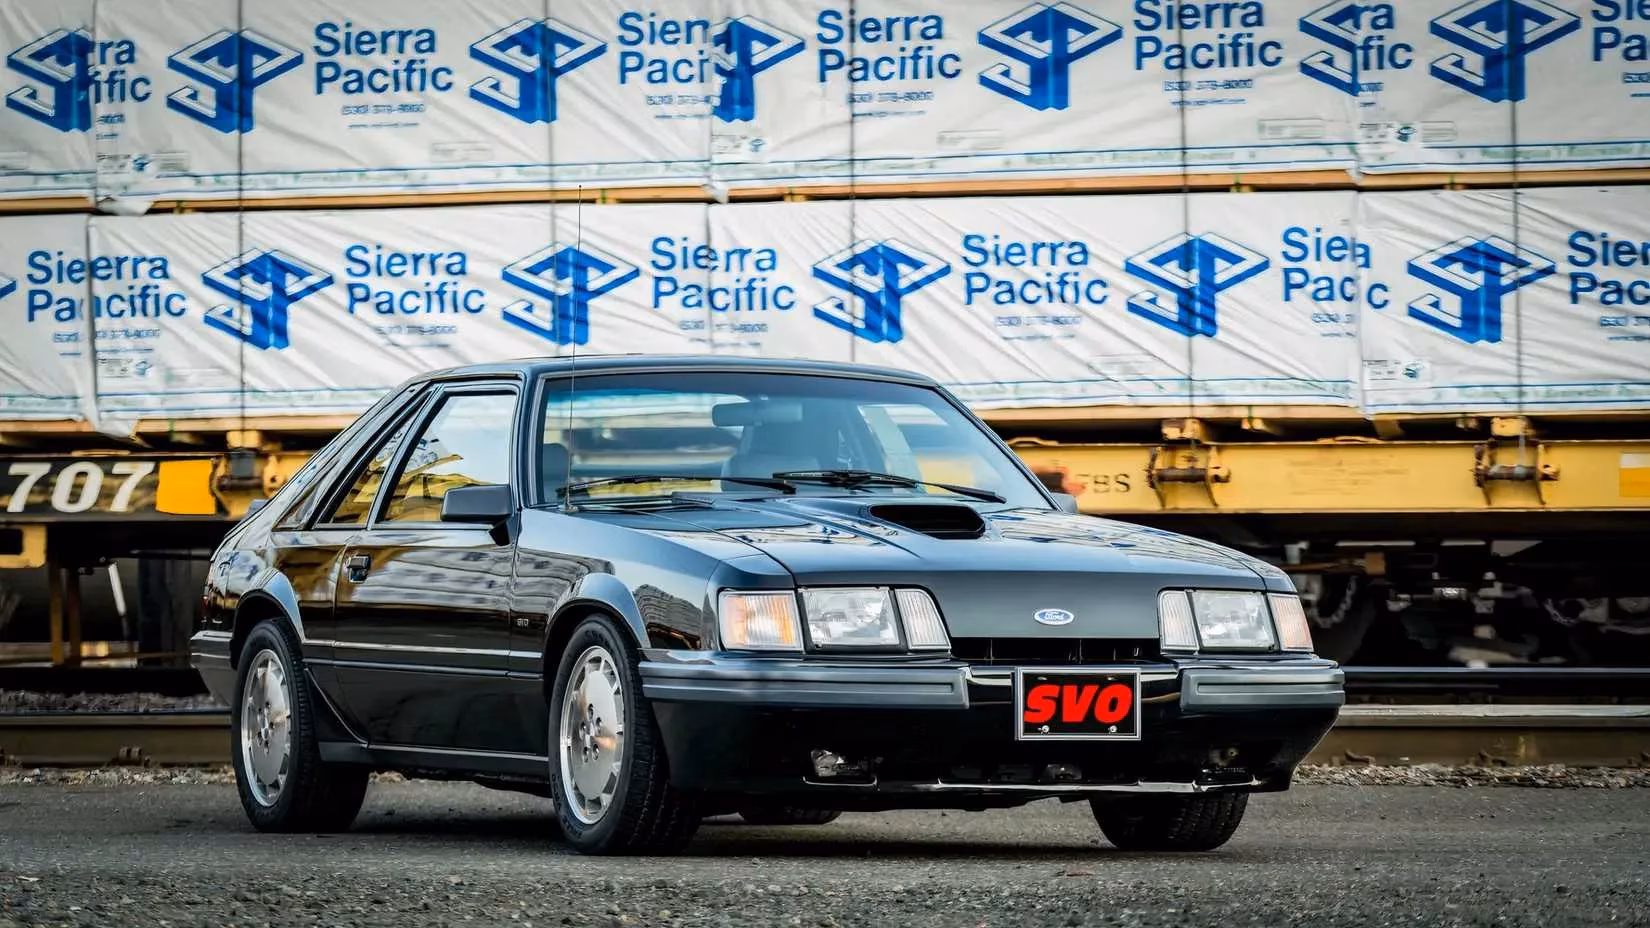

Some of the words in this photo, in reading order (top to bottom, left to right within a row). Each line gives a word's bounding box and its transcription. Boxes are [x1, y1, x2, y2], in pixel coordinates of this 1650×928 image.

[816, 10, 944, 44] Sierra
[1133, 0, 1264, 31] Sierra
[313, 22, 437, 57] Sierra
[1135, 33, 1283, 70] Pacific
[315, 59, 454, 96] Pacific
[619, 50, 710, 84] Paci
[817, 46, 961, 83] Pacific
[344, 245, 468, 277] Sierra
[650, 236, 777, 272] Sierra
[961, 235, 1089, 267] Sierra
[345, 282, 486, 315] Pacific
[654, 276, 796, 312] Pacific
[963, 272, 1109, 305] Pacific
[7, 461, 155, 512] 707
[1024, 684, 1132, 723] SVO
